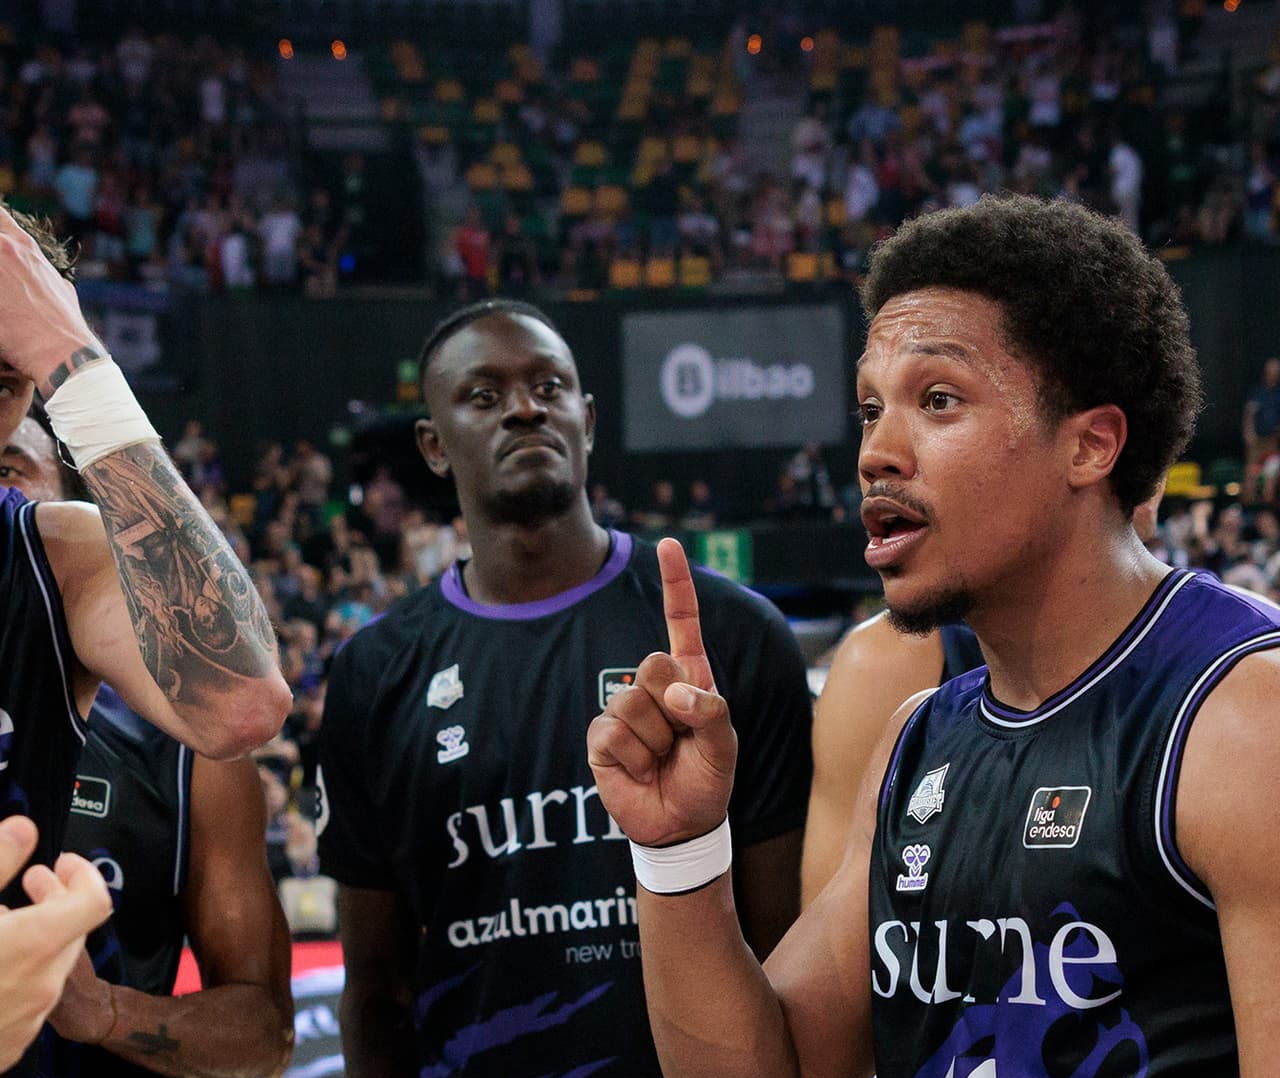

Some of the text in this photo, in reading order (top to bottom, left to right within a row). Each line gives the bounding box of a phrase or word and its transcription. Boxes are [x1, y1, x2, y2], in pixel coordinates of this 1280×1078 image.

[1034, 806, 1056, 825] liga
[1029, 823, 1076, 839] endesa
[898, 876, 926, 889] hummel
[565, 943, 613, 963] new
